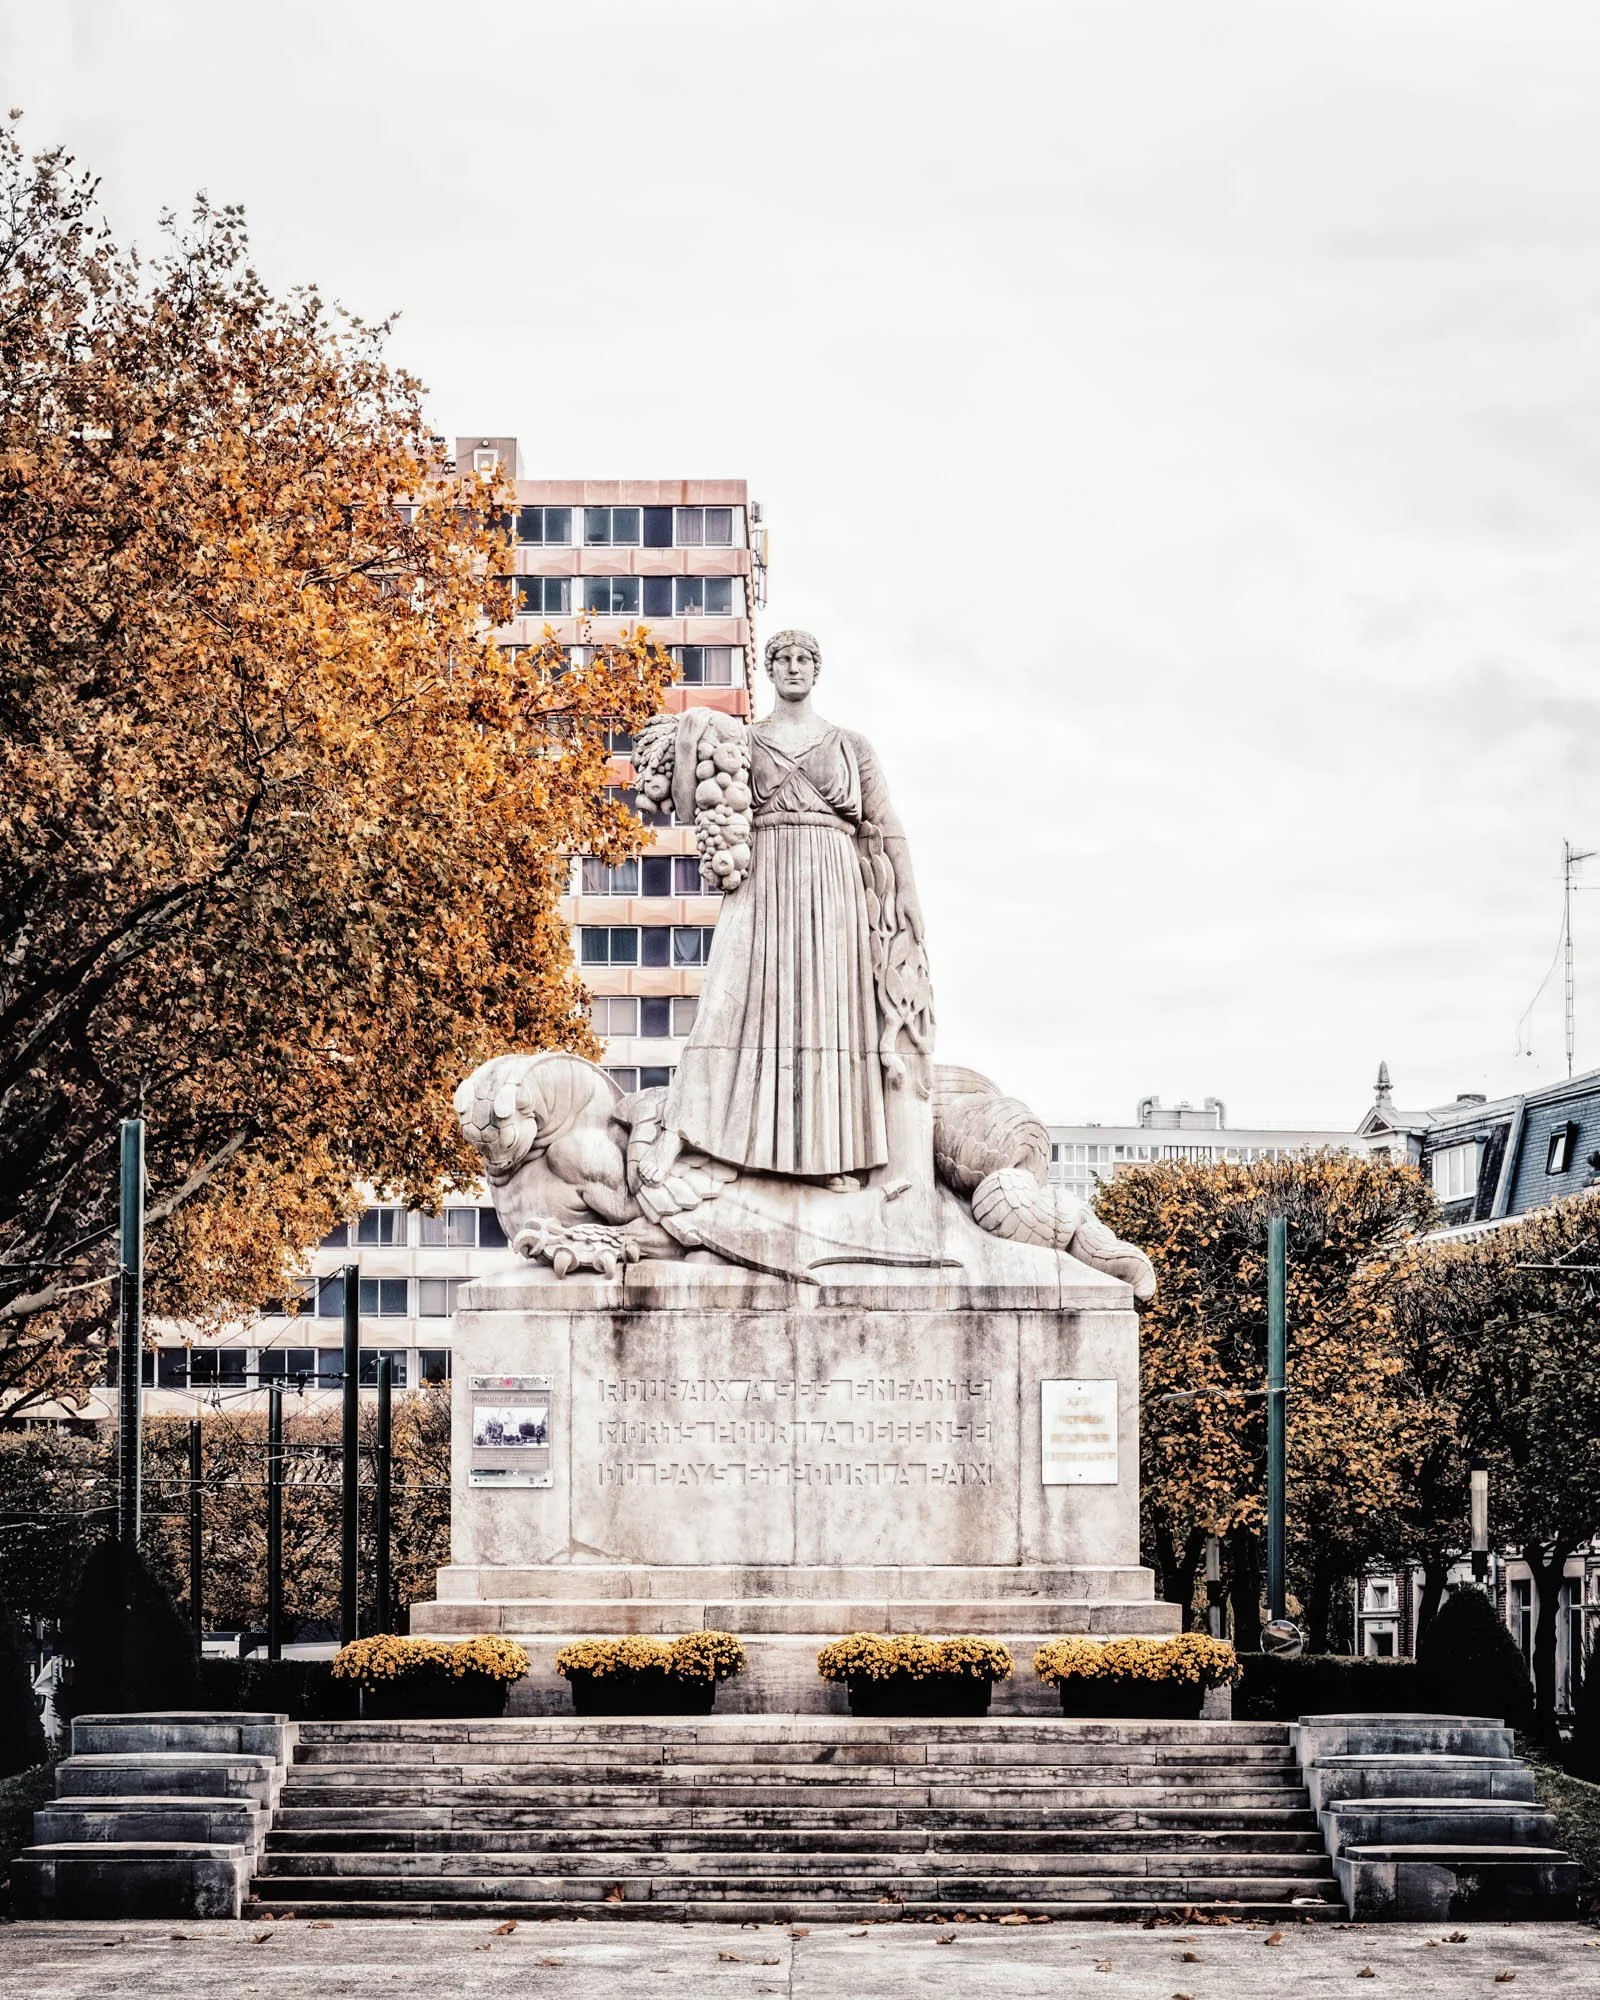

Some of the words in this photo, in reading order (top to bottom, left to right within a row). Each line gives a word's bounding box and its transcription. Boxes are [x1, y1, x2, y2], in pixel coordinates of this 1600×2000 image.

[602, 1379, 732, 1401] ROUBAIX
[745, 1379, 769, 1401] A
[775, 1379, 832, 1401] SES
[852, 1379, 986, 1401] ENFANTS
[602, 1421, 698, 1443] MORTS
[714, 1421, 791, 1443] POUR
[806, 1421, 840, 1443] LA
[853, 1421, 987, 1443] DEFENSE
[602, 1463, 639, 1485] DU
[656, 1463, 728, 1485] PAYS
[745, 1463, 783, 1485] ET
[789, 1463, 869, 1485] POUR
[878, 1463, 912, 1485] LA
[926, 1463, 991, 1485] PAIX
